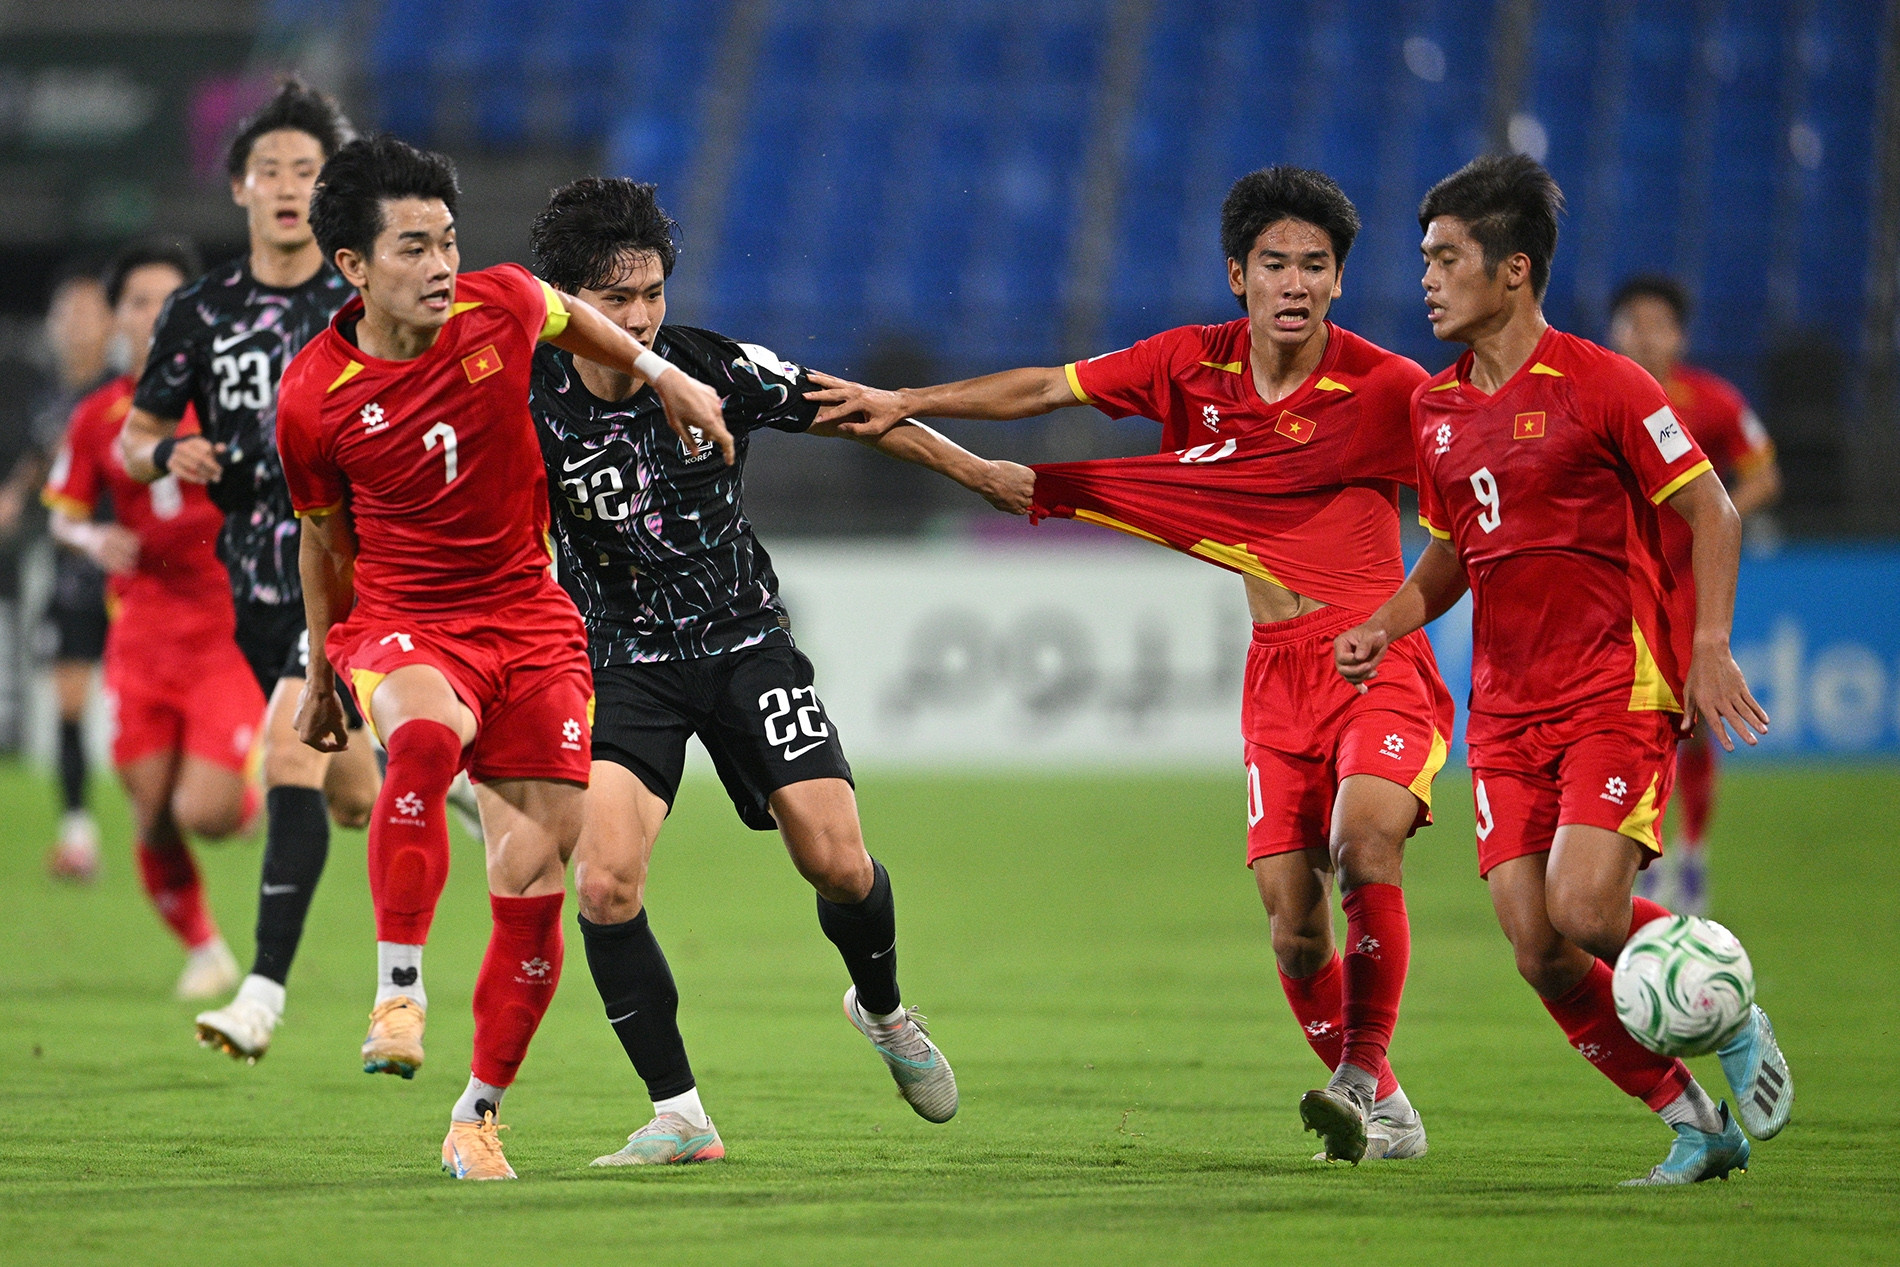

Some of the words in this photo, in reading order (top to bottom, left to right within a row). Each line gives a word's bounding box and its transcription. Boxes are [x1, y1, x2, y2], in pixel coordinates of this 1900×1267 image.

[211, 351, 271, 411] 23
[422, 421, 458, 485] 7
[685, 450, 713, 465] KOREA
[1659, 423, 1678, 444] AFC
[558, 466, 629, 522] 22
[1469, 466, 1501, 534] 9
[758, 685, 829, 746] 22
